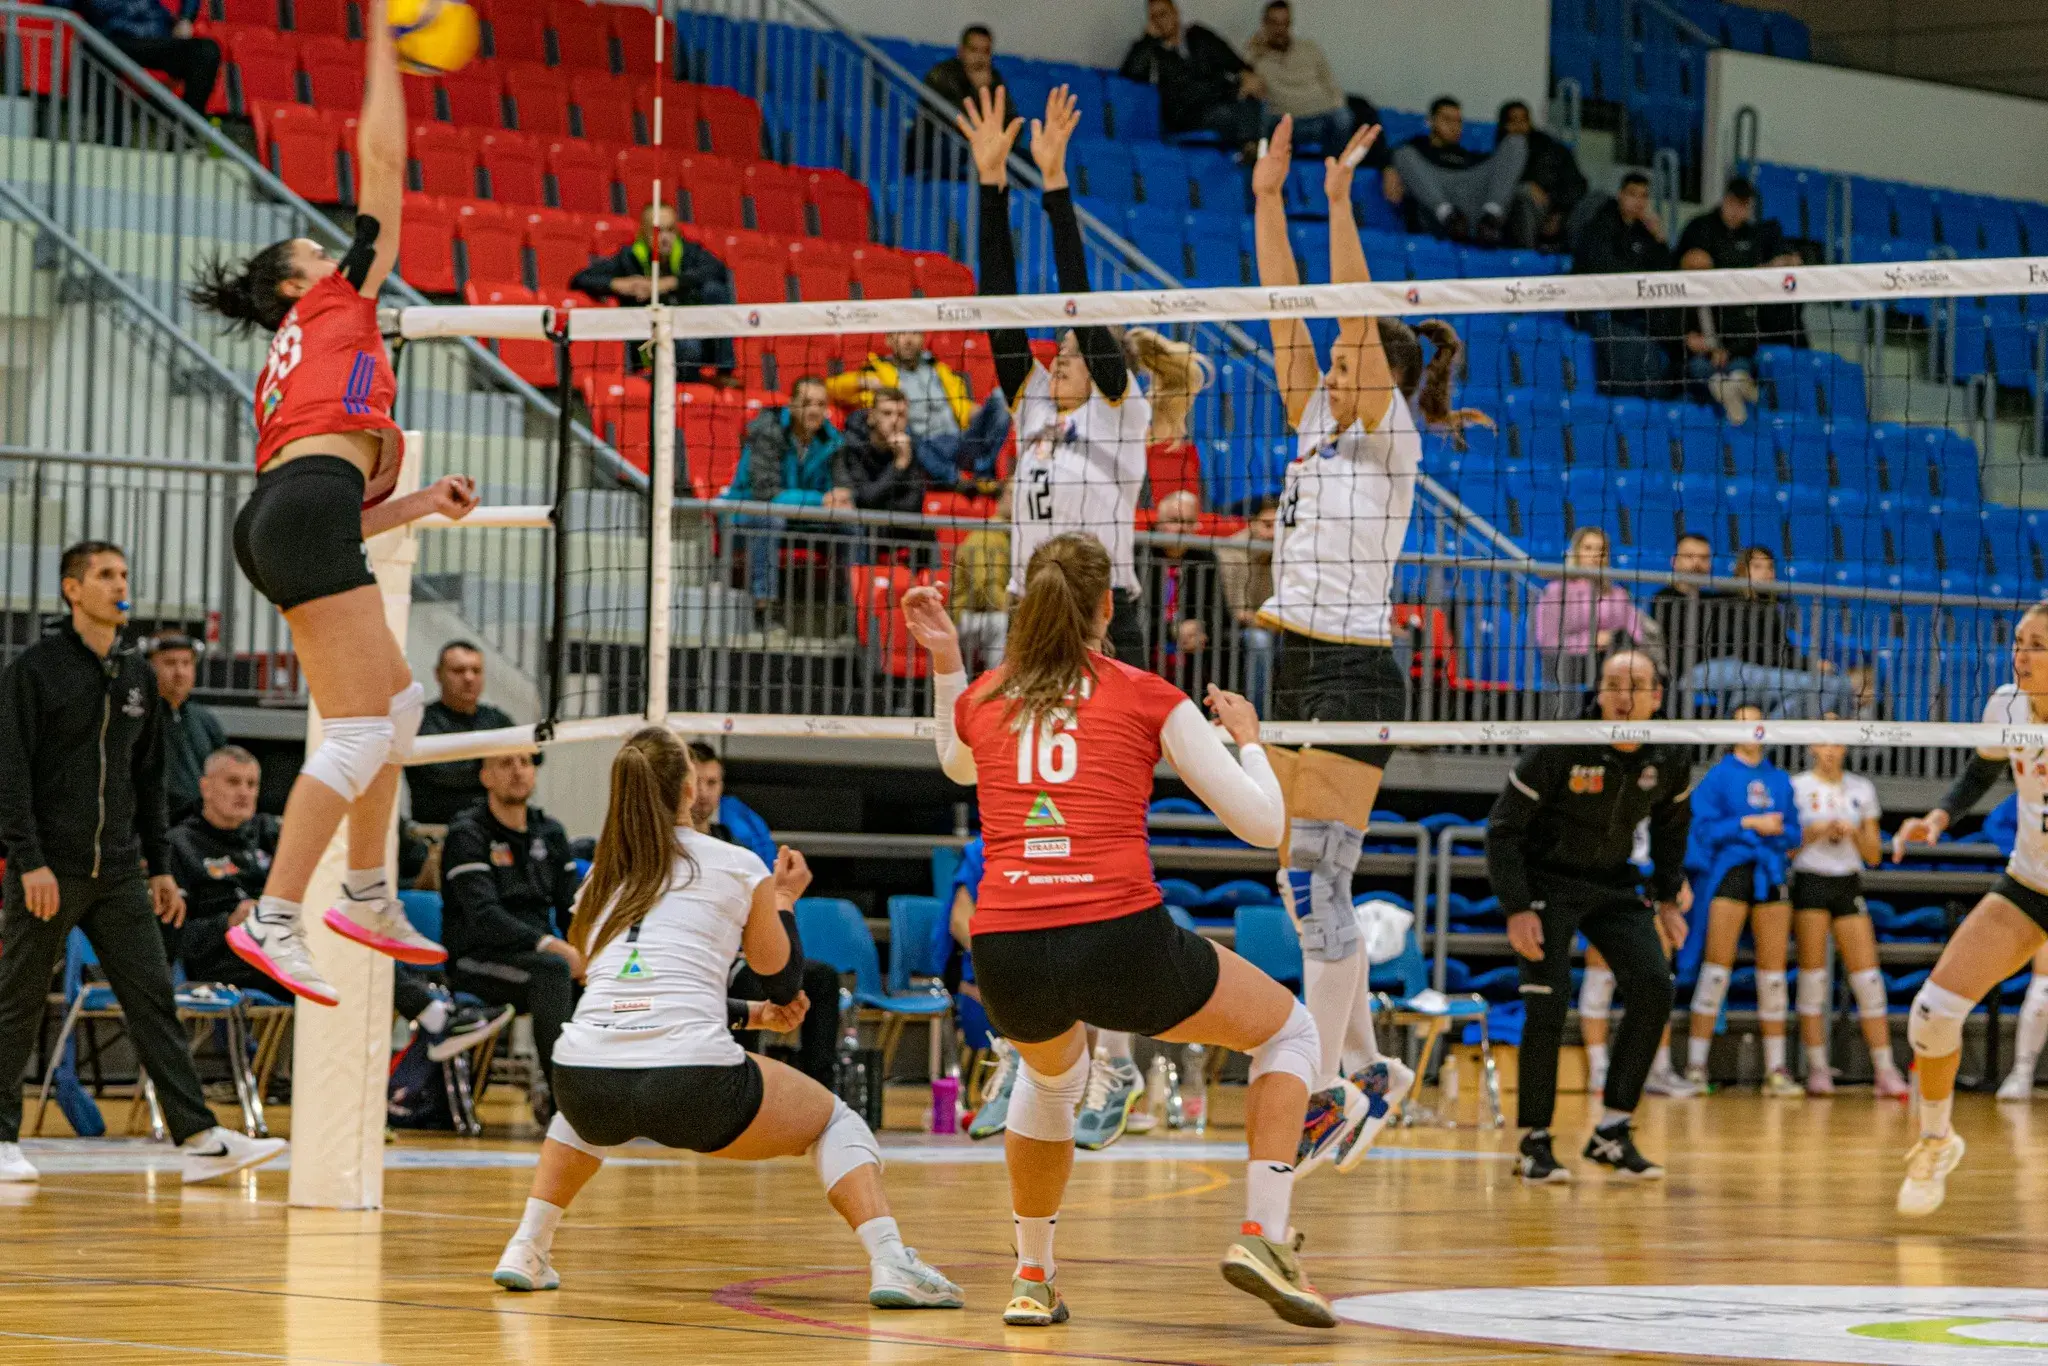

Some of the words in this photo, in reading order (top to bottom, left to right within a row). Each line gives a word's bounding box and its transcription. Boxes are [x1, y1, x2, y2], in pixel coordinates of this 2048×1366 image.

[1637, 279, 1687, 299] FATUM
[1027, 468, 1052, 520] 12
[1010, 707, 1078, 784] 16
[2001, 727, 2044, 745] FATUM
